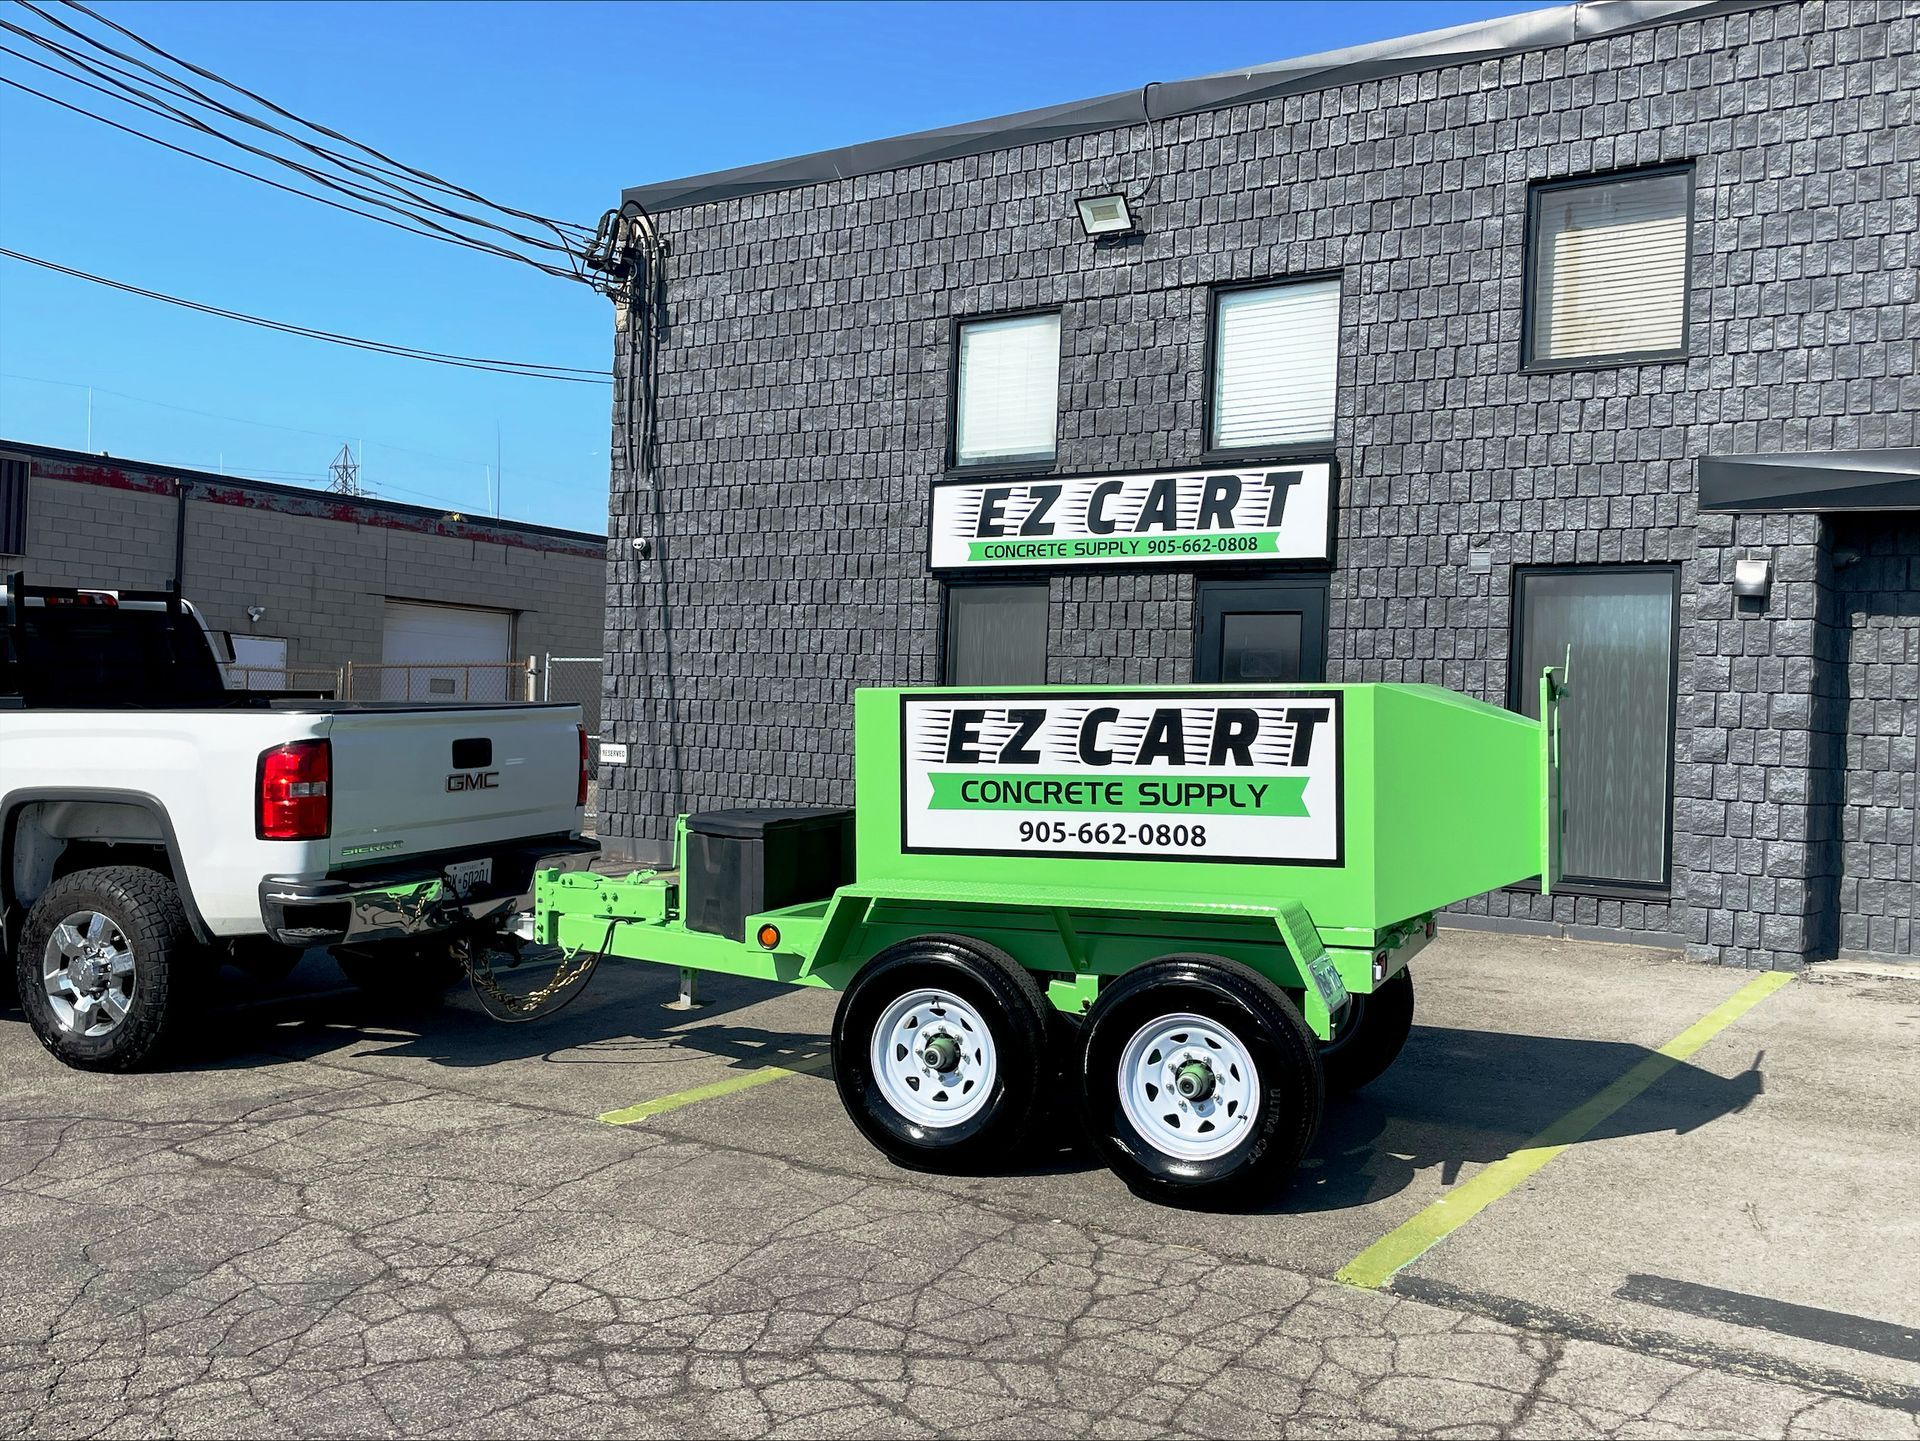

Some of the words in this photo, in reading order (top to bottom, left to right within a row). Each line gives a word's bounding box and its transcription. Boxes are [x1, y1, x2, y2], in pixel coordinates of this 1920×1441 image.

[976, 484, 1063, 538] EZ
[1086, 470, 1304, 535] CART
[984, 543, 1067, 559] CONCRETE
[1074, 540, 1140, 557] SUPPLY
[1147, 537, 1259, 555] 905-662-0808
[945, 708, 1047, 765] EZ
[1077, 706, 1331, 767] CART
[446, 770, 500, 793] GMC
[960, 779, 1124, 807] CONCRETE
[1138, 782, 1270, 809] SUPPLY
[1018, 820, 1207, 848] 905-662-0808
[341, 840, 405, 857] SIERRA
